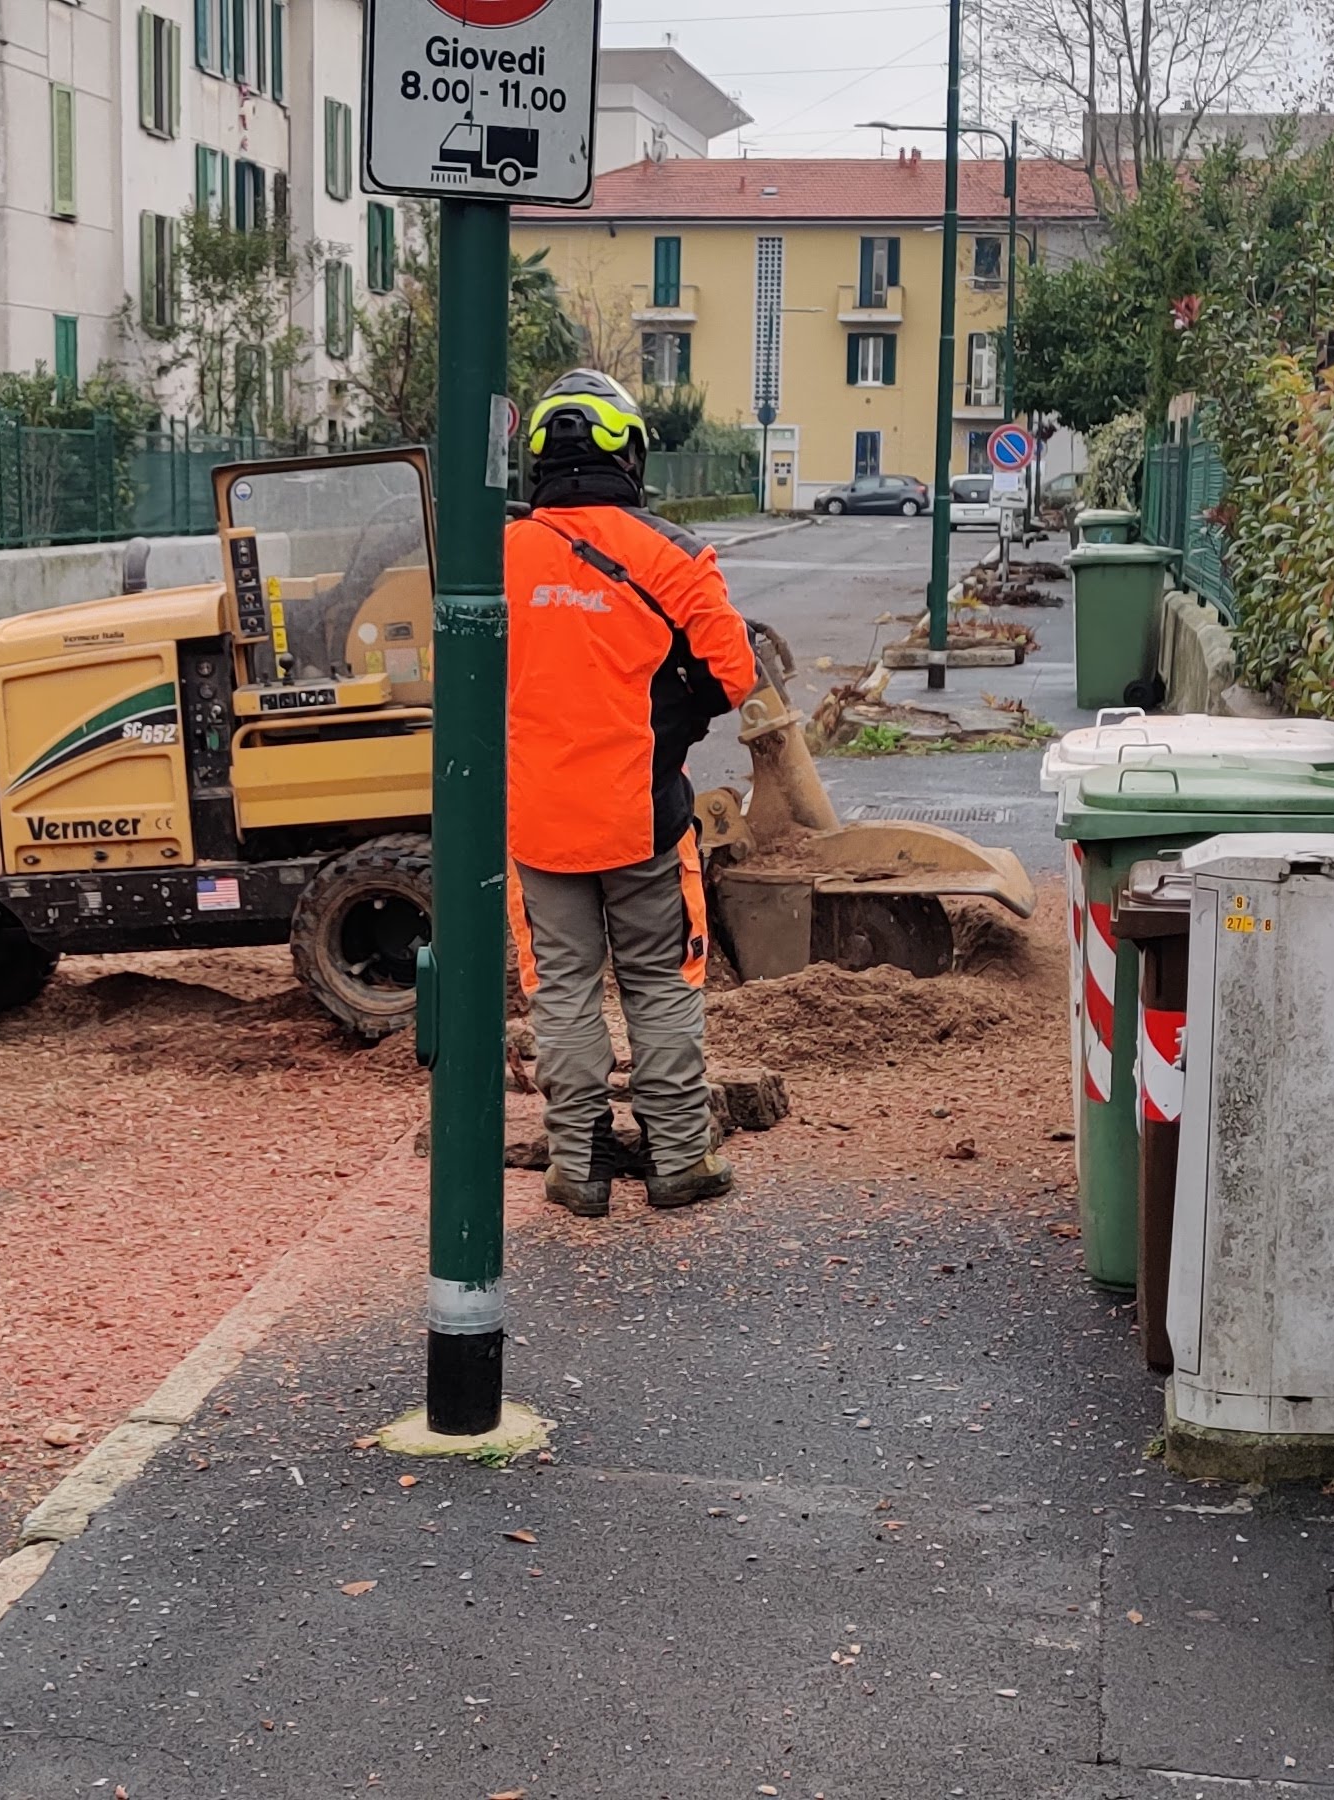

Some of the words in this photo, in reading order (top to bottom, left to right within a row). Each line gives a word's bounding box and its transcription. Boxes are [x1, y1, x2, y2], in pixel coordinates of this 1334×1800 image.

[425, 35, 546, 76] Giovedi
[400, 70, 470, 104] 8.00
[498, 79, 567, 113] 11.00
[26, 816, 141, 841] Vermeer
